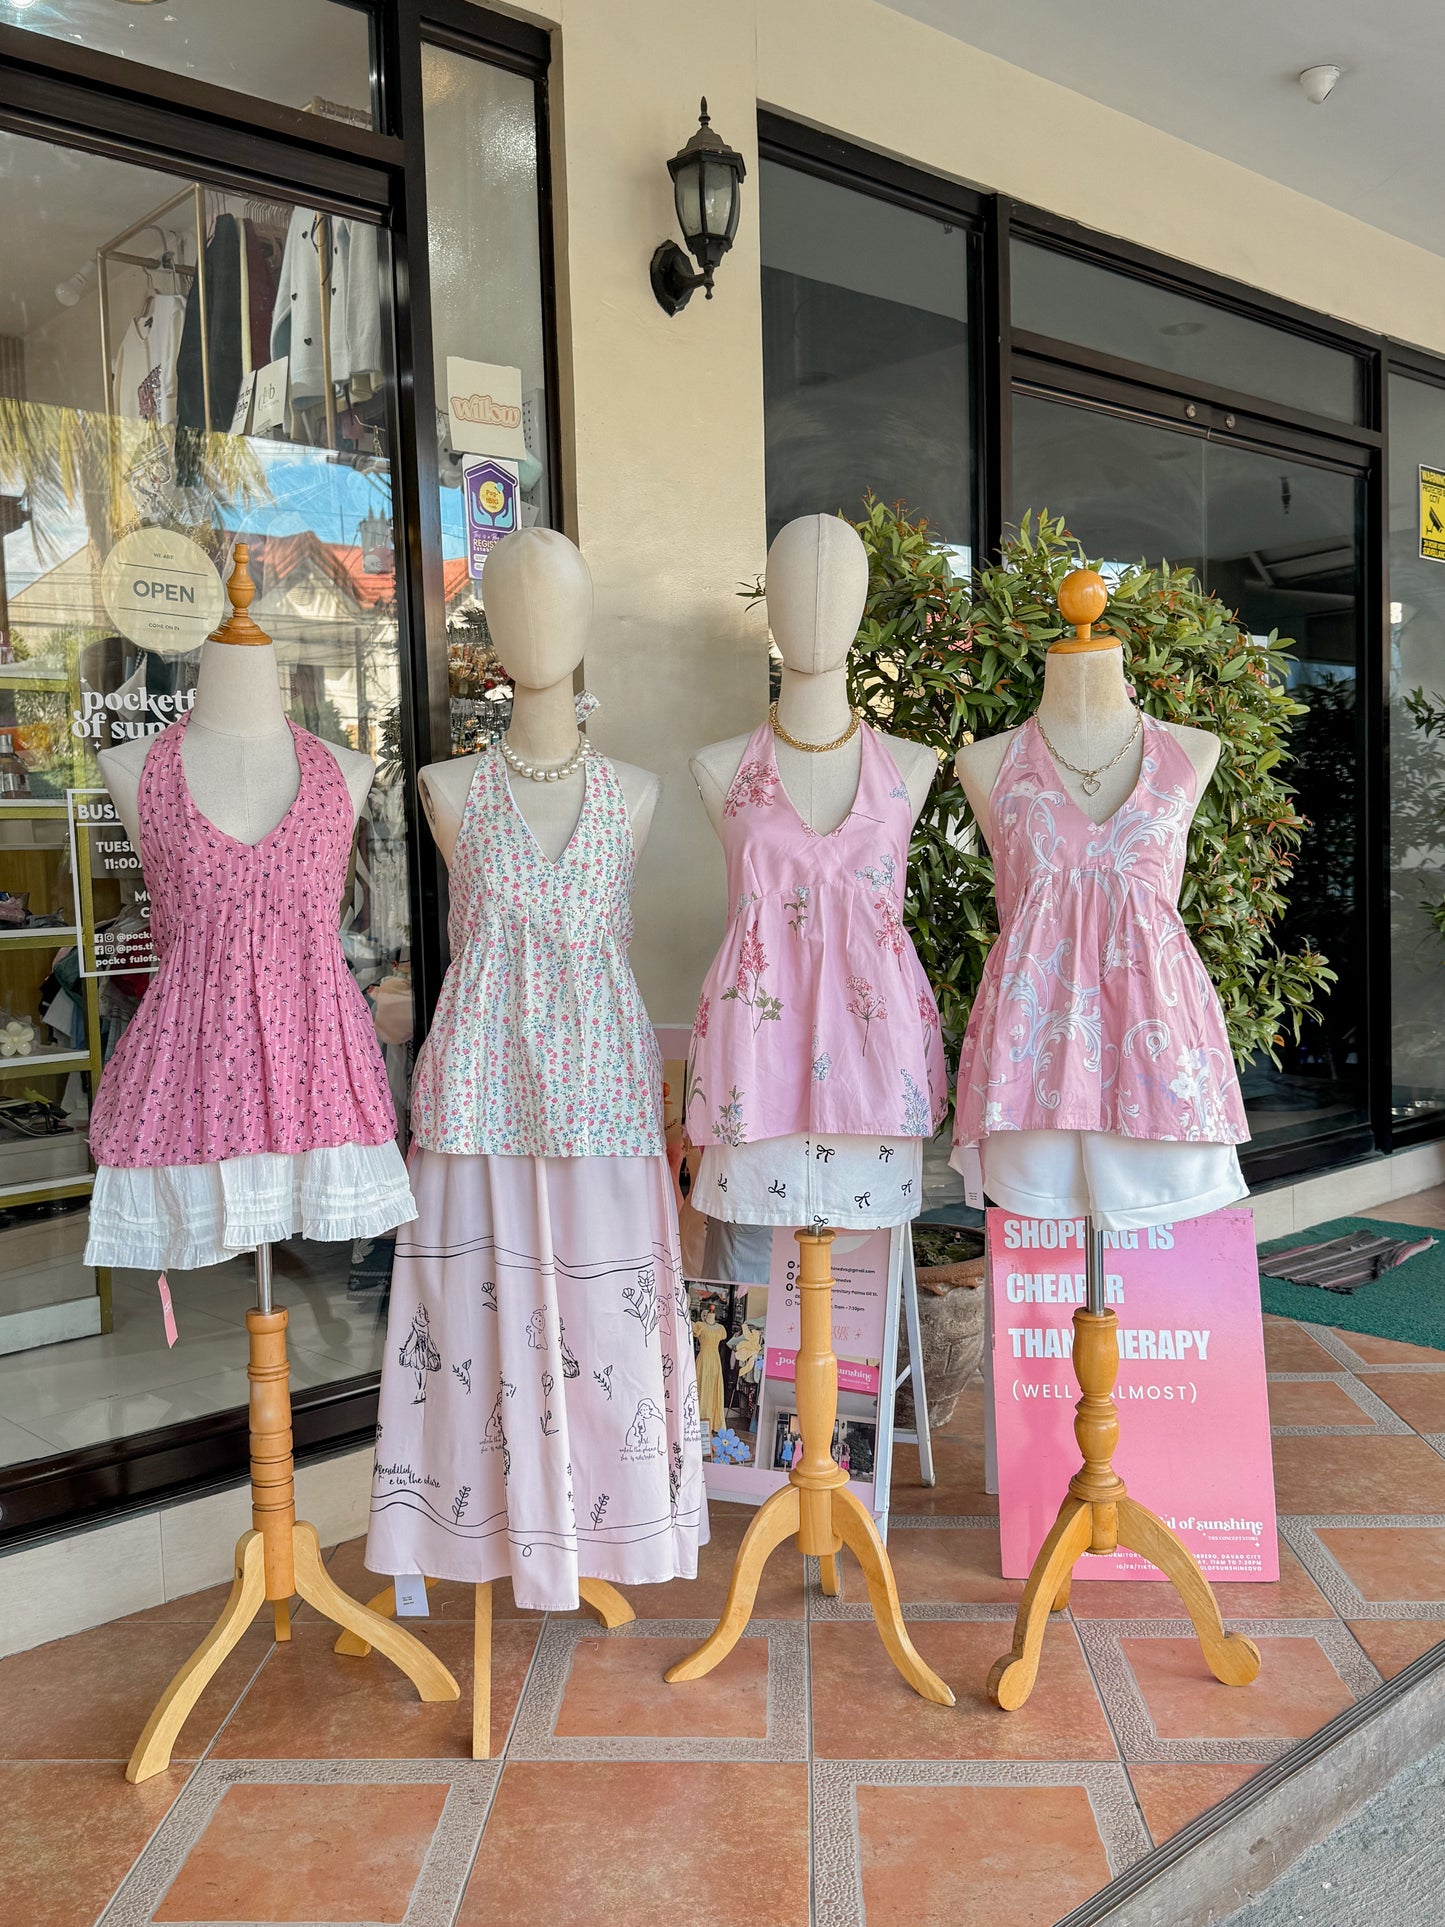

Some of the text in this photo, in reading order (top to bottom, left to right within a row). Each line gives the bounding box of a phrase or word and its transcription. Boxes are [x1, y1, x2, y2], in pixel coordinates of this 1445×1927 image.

[451, 395, 521, 428] willow
[473, 538, 497, 549] REGIS
[133, 579, 195, 604] OPEN
[148, 622, 164, 630] COME
[78, 687, 197, 722] pocketf
[71, 712, 107, 739] of
[129, 954, 160, 964] fulofs
[1004, 1219, 1174, 1250] SHOPPNG IS
[1006, 1273, 1125, 1304] CHEAPR
[1012, 1380, 1072, 1401] (WELL
[1179, 1517, 1195, 1530] of
[1196, 1518, 1263, 1536] sunshine
